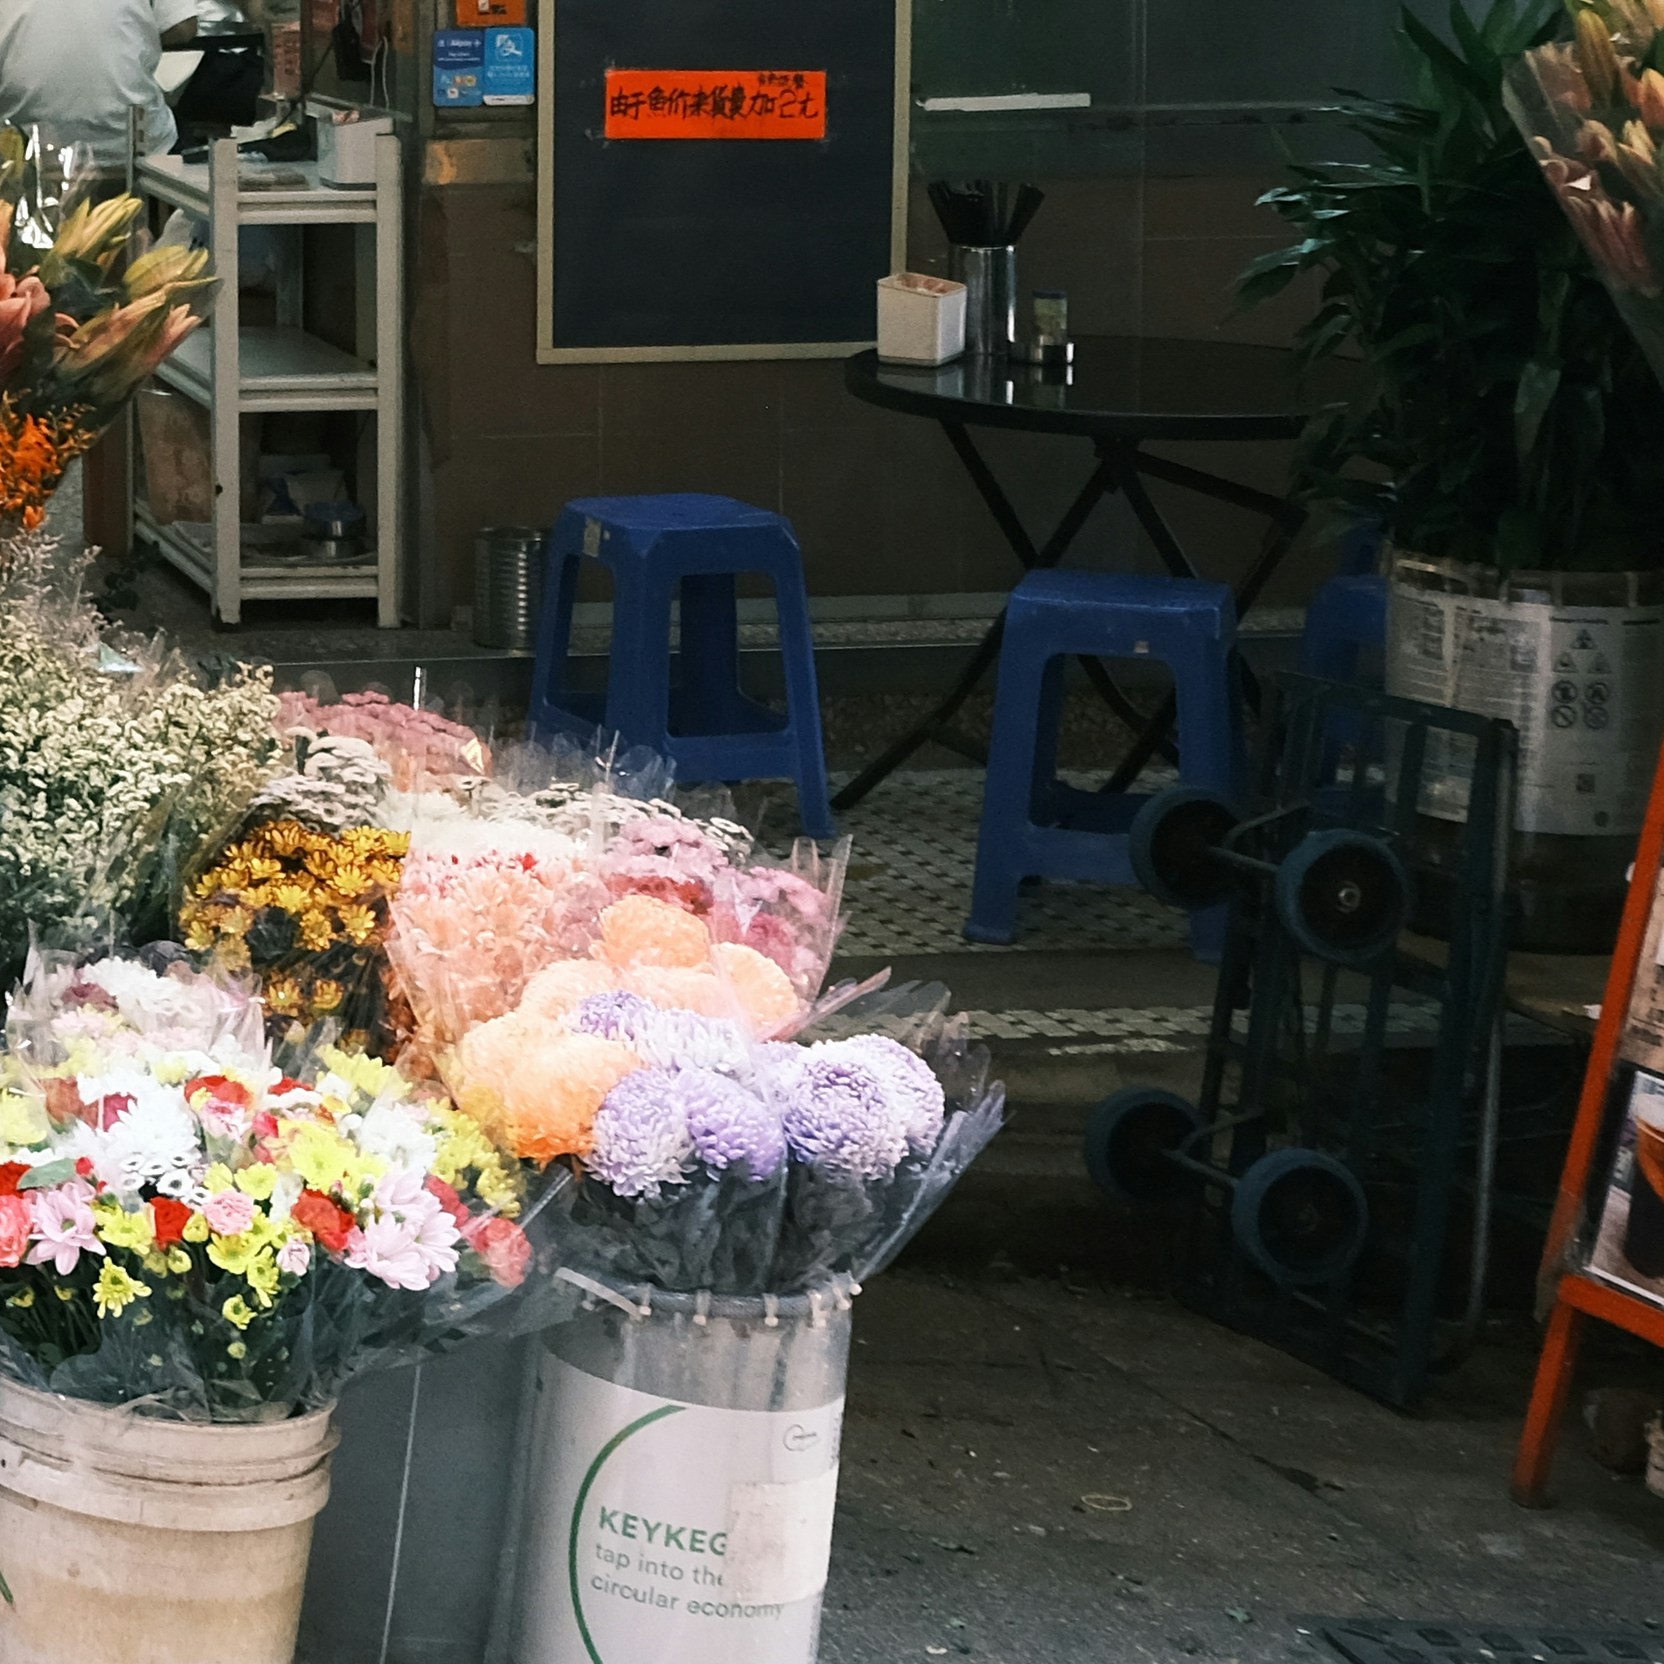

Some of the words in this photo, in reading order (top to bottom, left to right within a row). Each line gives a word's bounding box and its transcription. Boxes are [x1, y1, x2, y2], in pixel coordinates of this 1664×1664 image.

[598, 1505, 730, 1557] KEYKEG
[595, 1543, 631, 1571] tap
[638, 1552, 685, 1581] into
[590, 1572, 681, 1611] circular
[686, 1598, 785, 1621] economy
